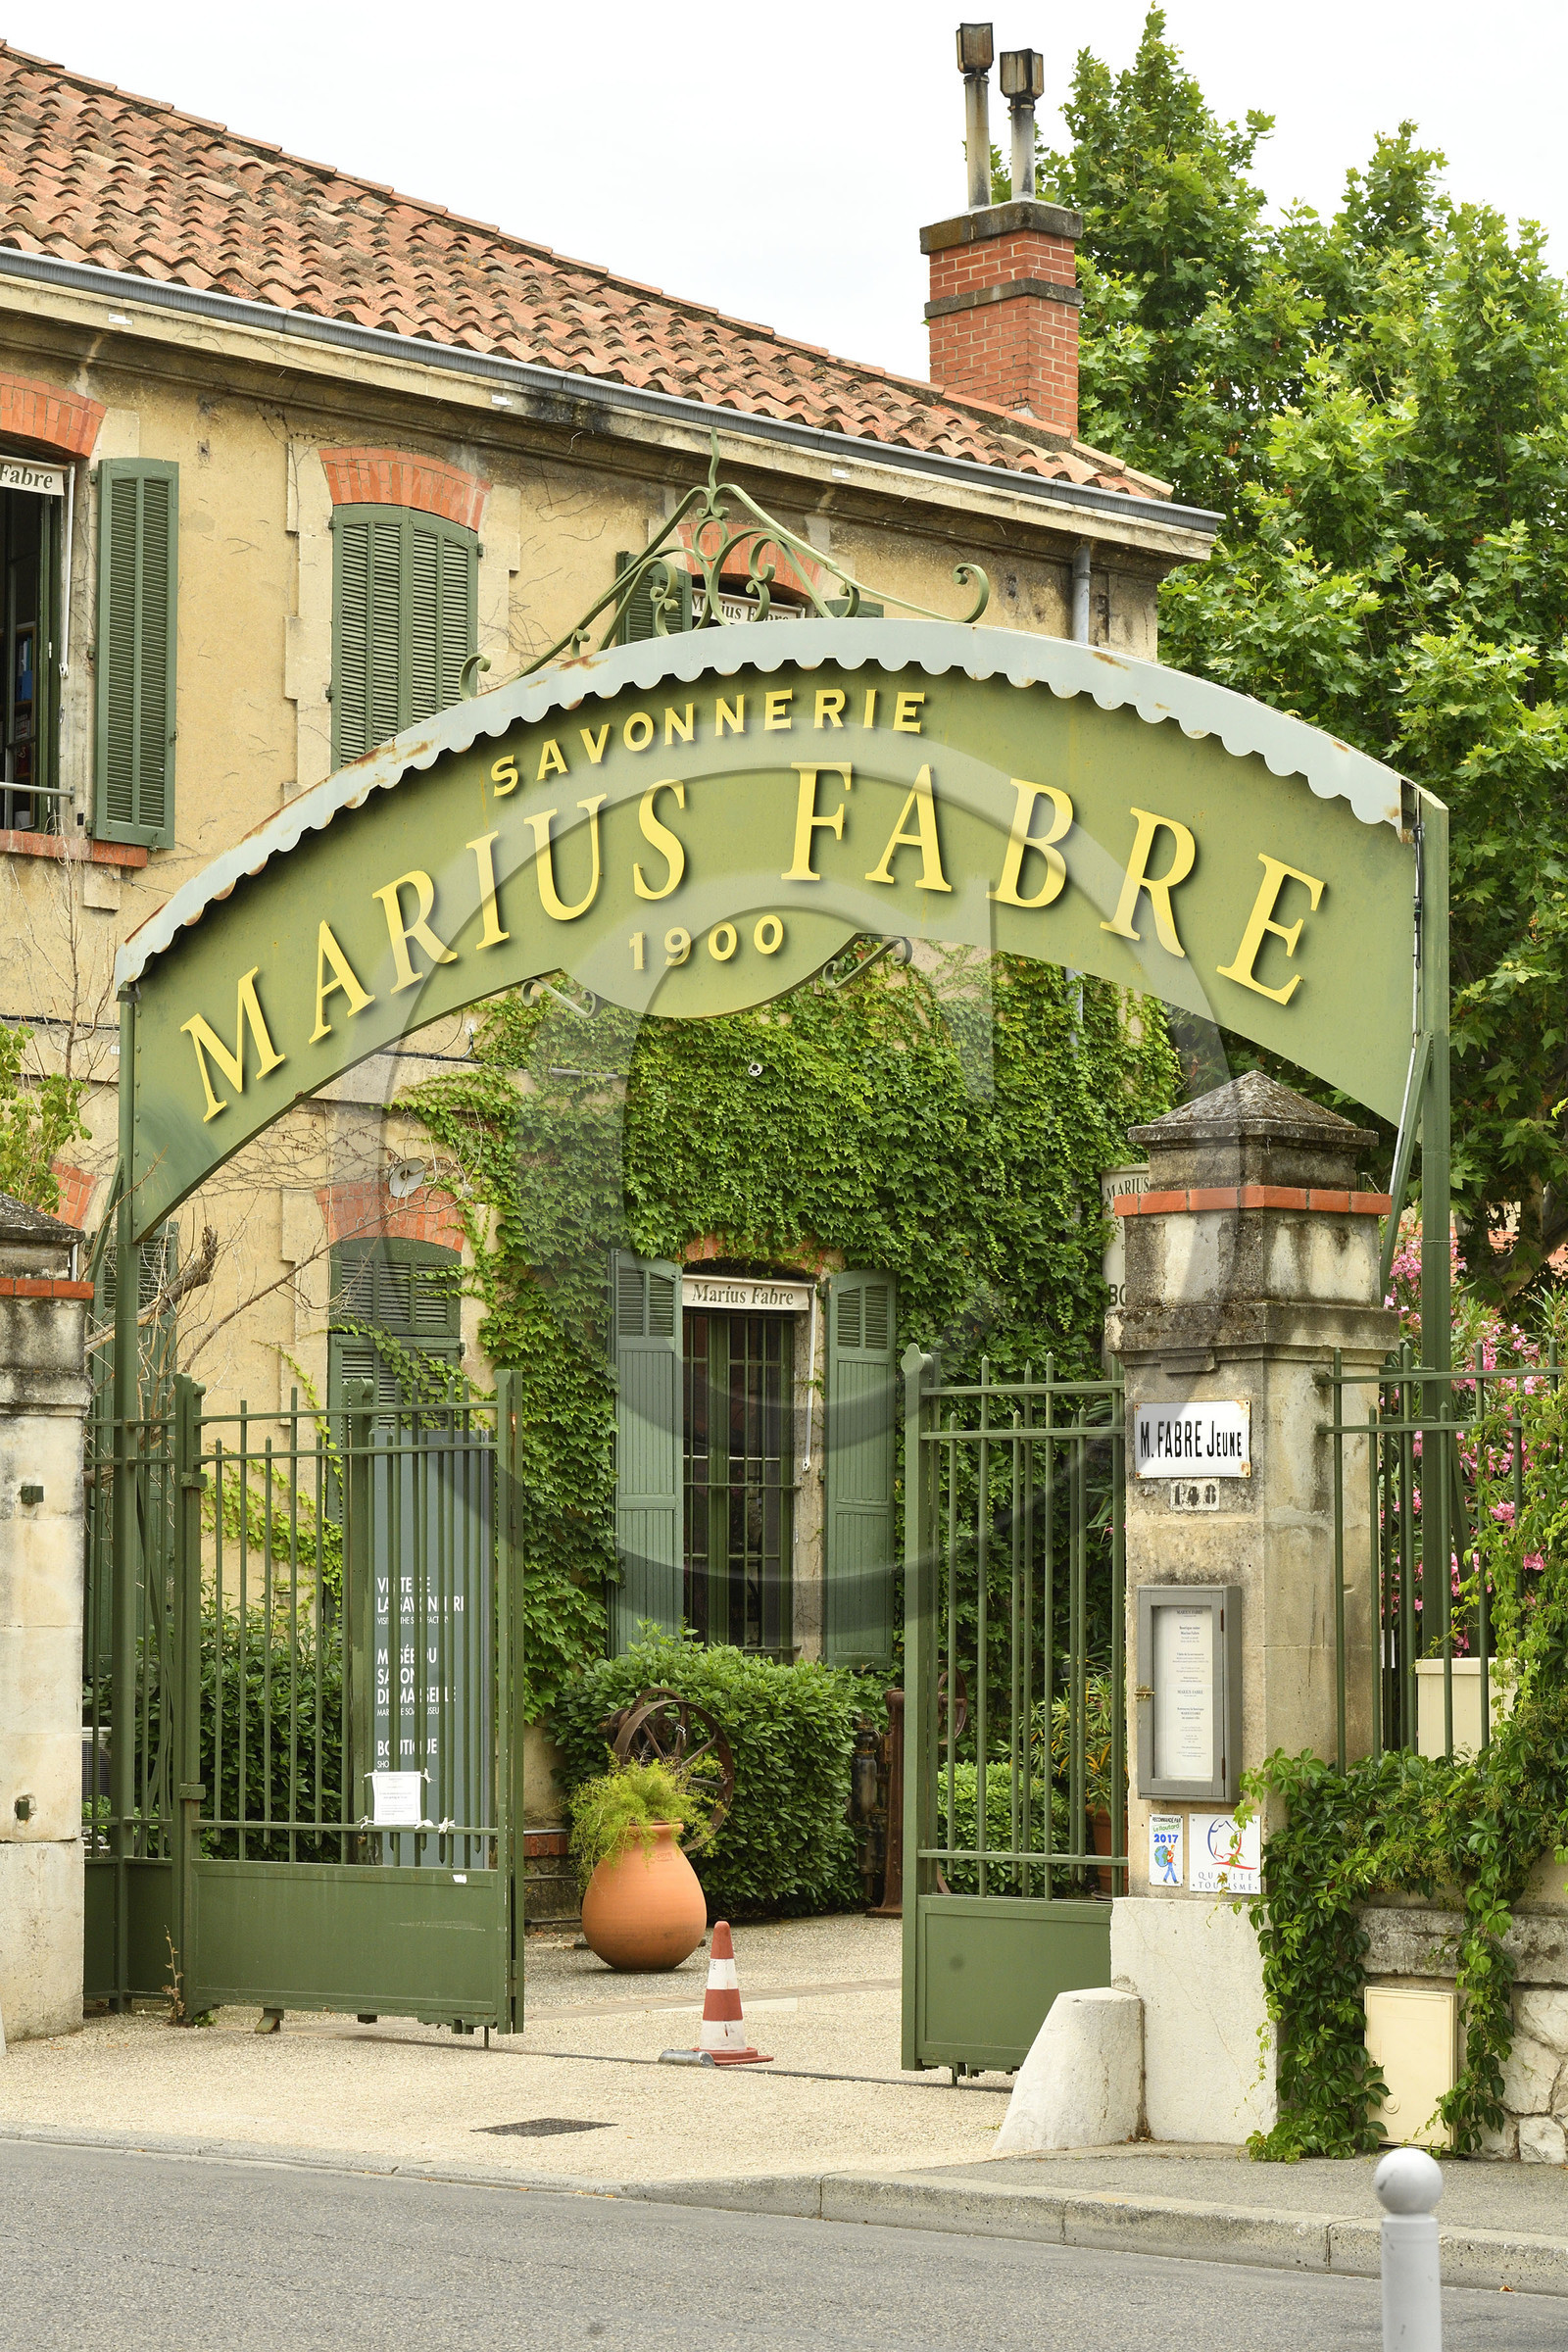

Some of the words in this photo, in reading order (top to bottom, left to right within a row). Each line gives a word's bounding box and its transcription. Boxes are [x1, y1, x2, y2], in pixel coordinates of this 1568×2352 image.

[0, 463, 53, 489] Fabre
[692, 594, 742, 619] Mius
[490, 688, 925, 798] SAVONNERIE
[179, 779, 686, 1123] MARIUS
[781, 761, 1326, 1005] FABRE
[629, 912, 783, 971] 1900
[1106, 1177, 1150, 1200] MARIUS
[692, 1284, 746, 1303] Marius
[751, 1287, 794, 1304] Fabre
[1141, 1421, 1154, 1457] M.
[1157, 1420, 1202, 1457] FABRE
[1173, 1484, 1217, 1506] 148
[377, 1576, 413, 1593] VITE
[400, 1595, 465, 1613] AVNRI
[377, 1643, 415, 1665] MÉE
[377, 1667, 415, 1685] SAO
[400, 1686, 456, 1703] MAEIL
[377, 1738, 437, 1756] BOTIE
[1153, 1834, 1179, 1843] 2017
[1198, 1871, 1252, 1881] QUITÉ
